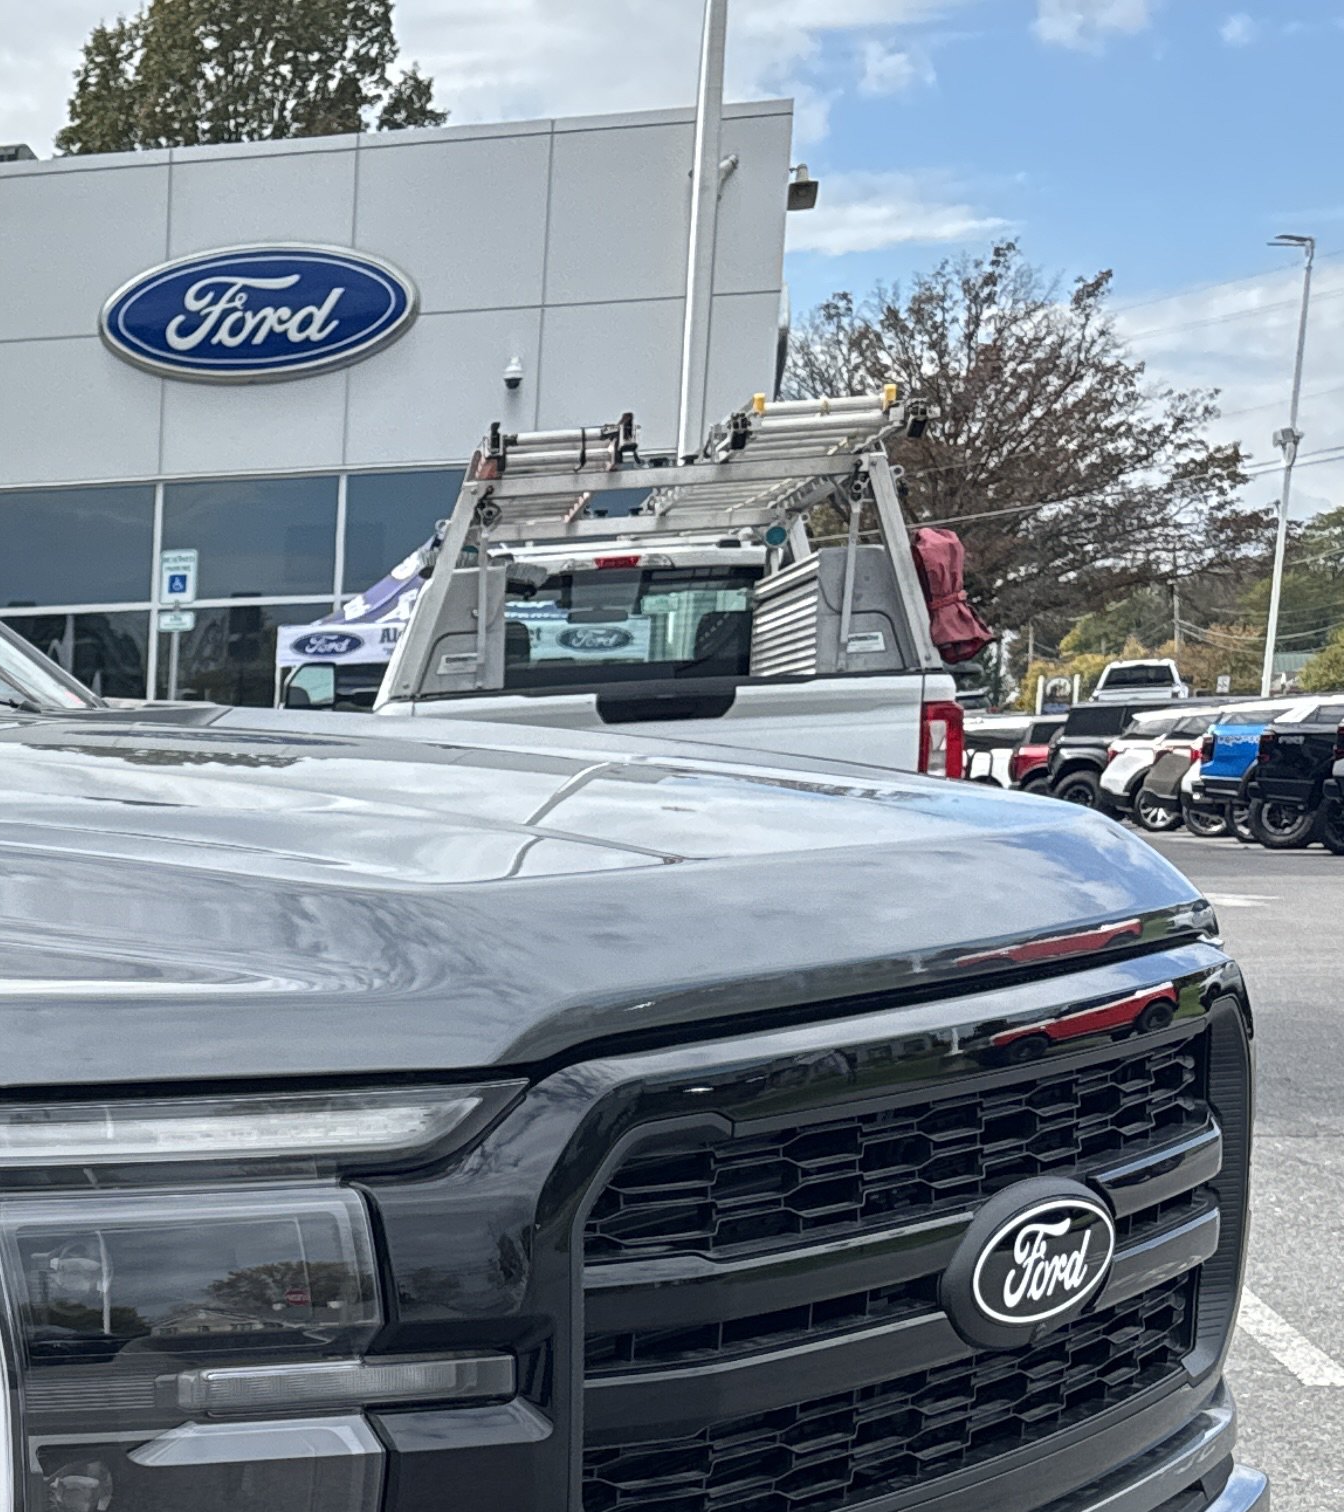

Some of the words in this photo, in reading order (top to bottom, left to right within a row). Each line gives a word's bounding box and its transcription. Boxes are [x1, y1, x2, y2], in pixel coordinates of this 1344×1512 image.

[165, 273, 346, 351] Ford
[304, 634, 352, 654] Ford
[571, 628, 618, 648] Ford
[1003, 1217, 1092, 1308] Ford
